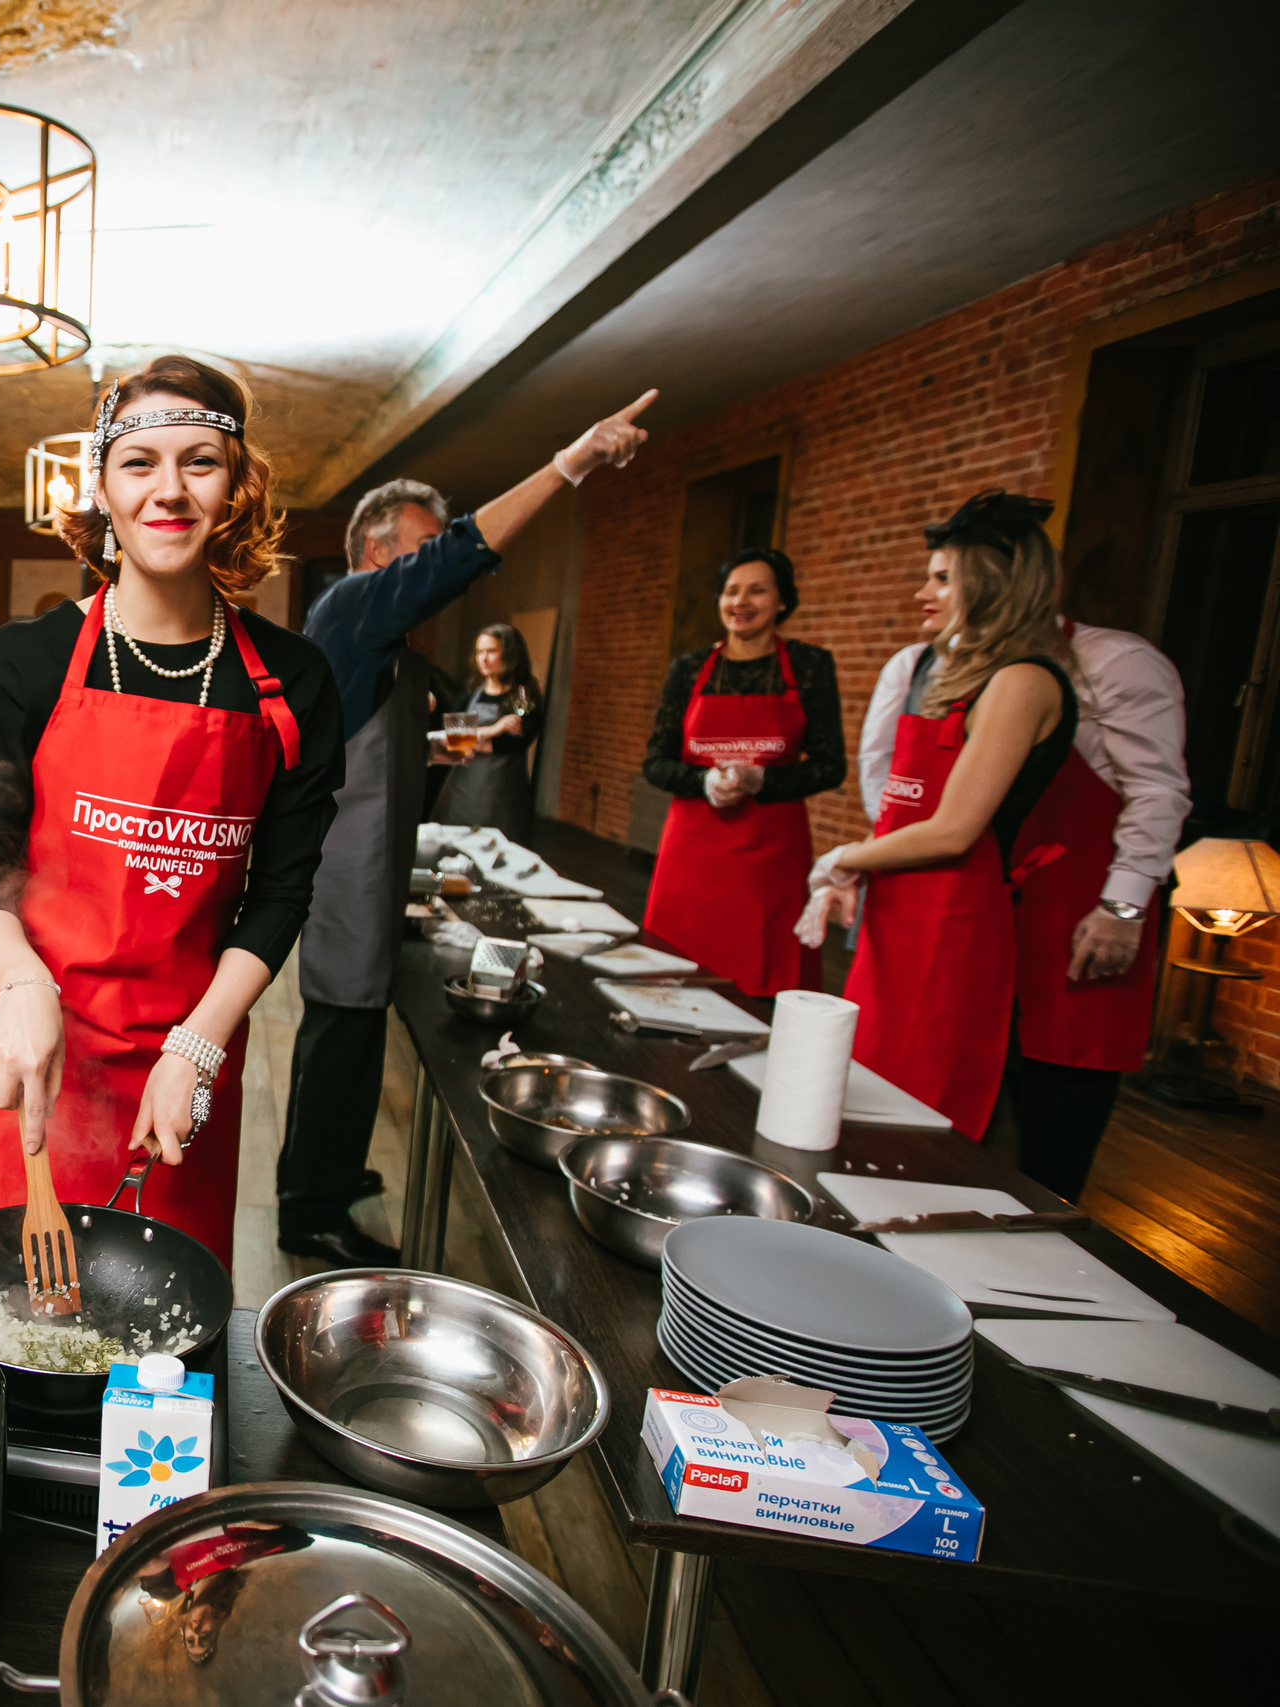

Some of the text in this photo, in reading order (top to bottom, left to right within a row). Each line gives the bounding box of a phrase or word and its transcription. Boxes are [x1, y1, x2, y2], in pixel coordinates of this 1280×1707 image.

[73, 799, 252, 847] ПростоVKUSNO
[118, 838, 217, 861] КУЛИНАРНАЯ СТУДИЯ
[125, 854, 203, 876] MAUNFELD
[659, 1391, 716, 1406] Paclan
[886, 1423, 912, 1433] 100
[696, 1448, 806, 1470] виниловые
[690, 1468, 743, 1488] Paclan
[877, 1477, 931, 1496] размер L
[758, 1492, 841, 1515] перчатки
[935, 1507, 969, 1519] размер
[755, 1508, 855, 1533] виниловые
[943, 1517, 957, 1534] L
[935, 1537, 960, 1550] 100
[932, 1549, 956, 1558] штук
